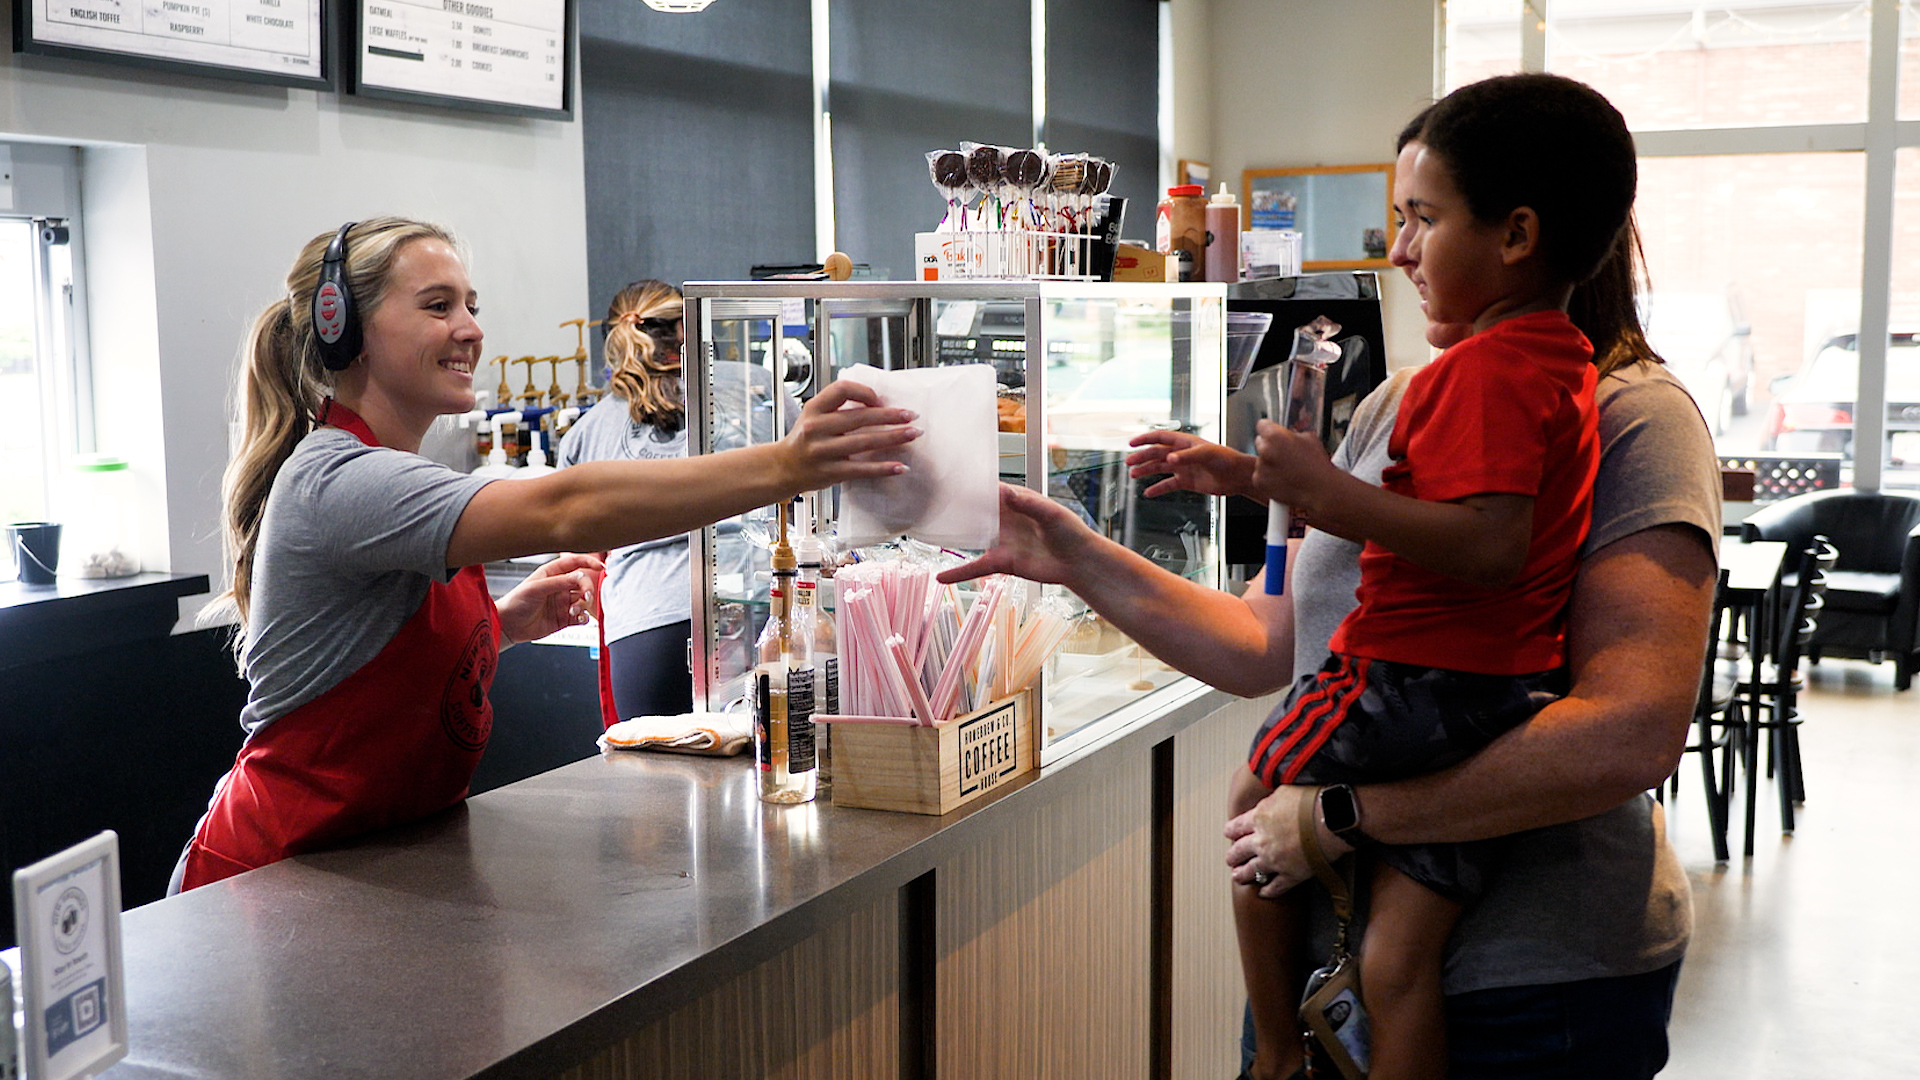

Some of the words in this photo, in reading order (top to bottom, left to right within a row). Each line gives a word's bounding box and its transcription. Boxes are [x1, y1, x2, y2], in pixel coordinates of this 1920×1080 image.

[163, 1, 190, 13] PUMPKIN
[369, 5, 393, 18] OATMEAL
[443, 0, 463, 13] OTHER
[466, 3, 493, 19] GOODIES
[70, 8, 98, 20] ENGLISH
[99, 11, 120, 24] TOFFEE
[246, 14, 262, 24] WHITE
[264, 16, 294, 29] CHOCOLATE
[170, 22, 204, 35] RASPBERRY
[385, 28, 407, 40] WAFFLES
[965, 720, 995, 745] HOMEBREW
[965, 732, 1010, 779] COFFEE
